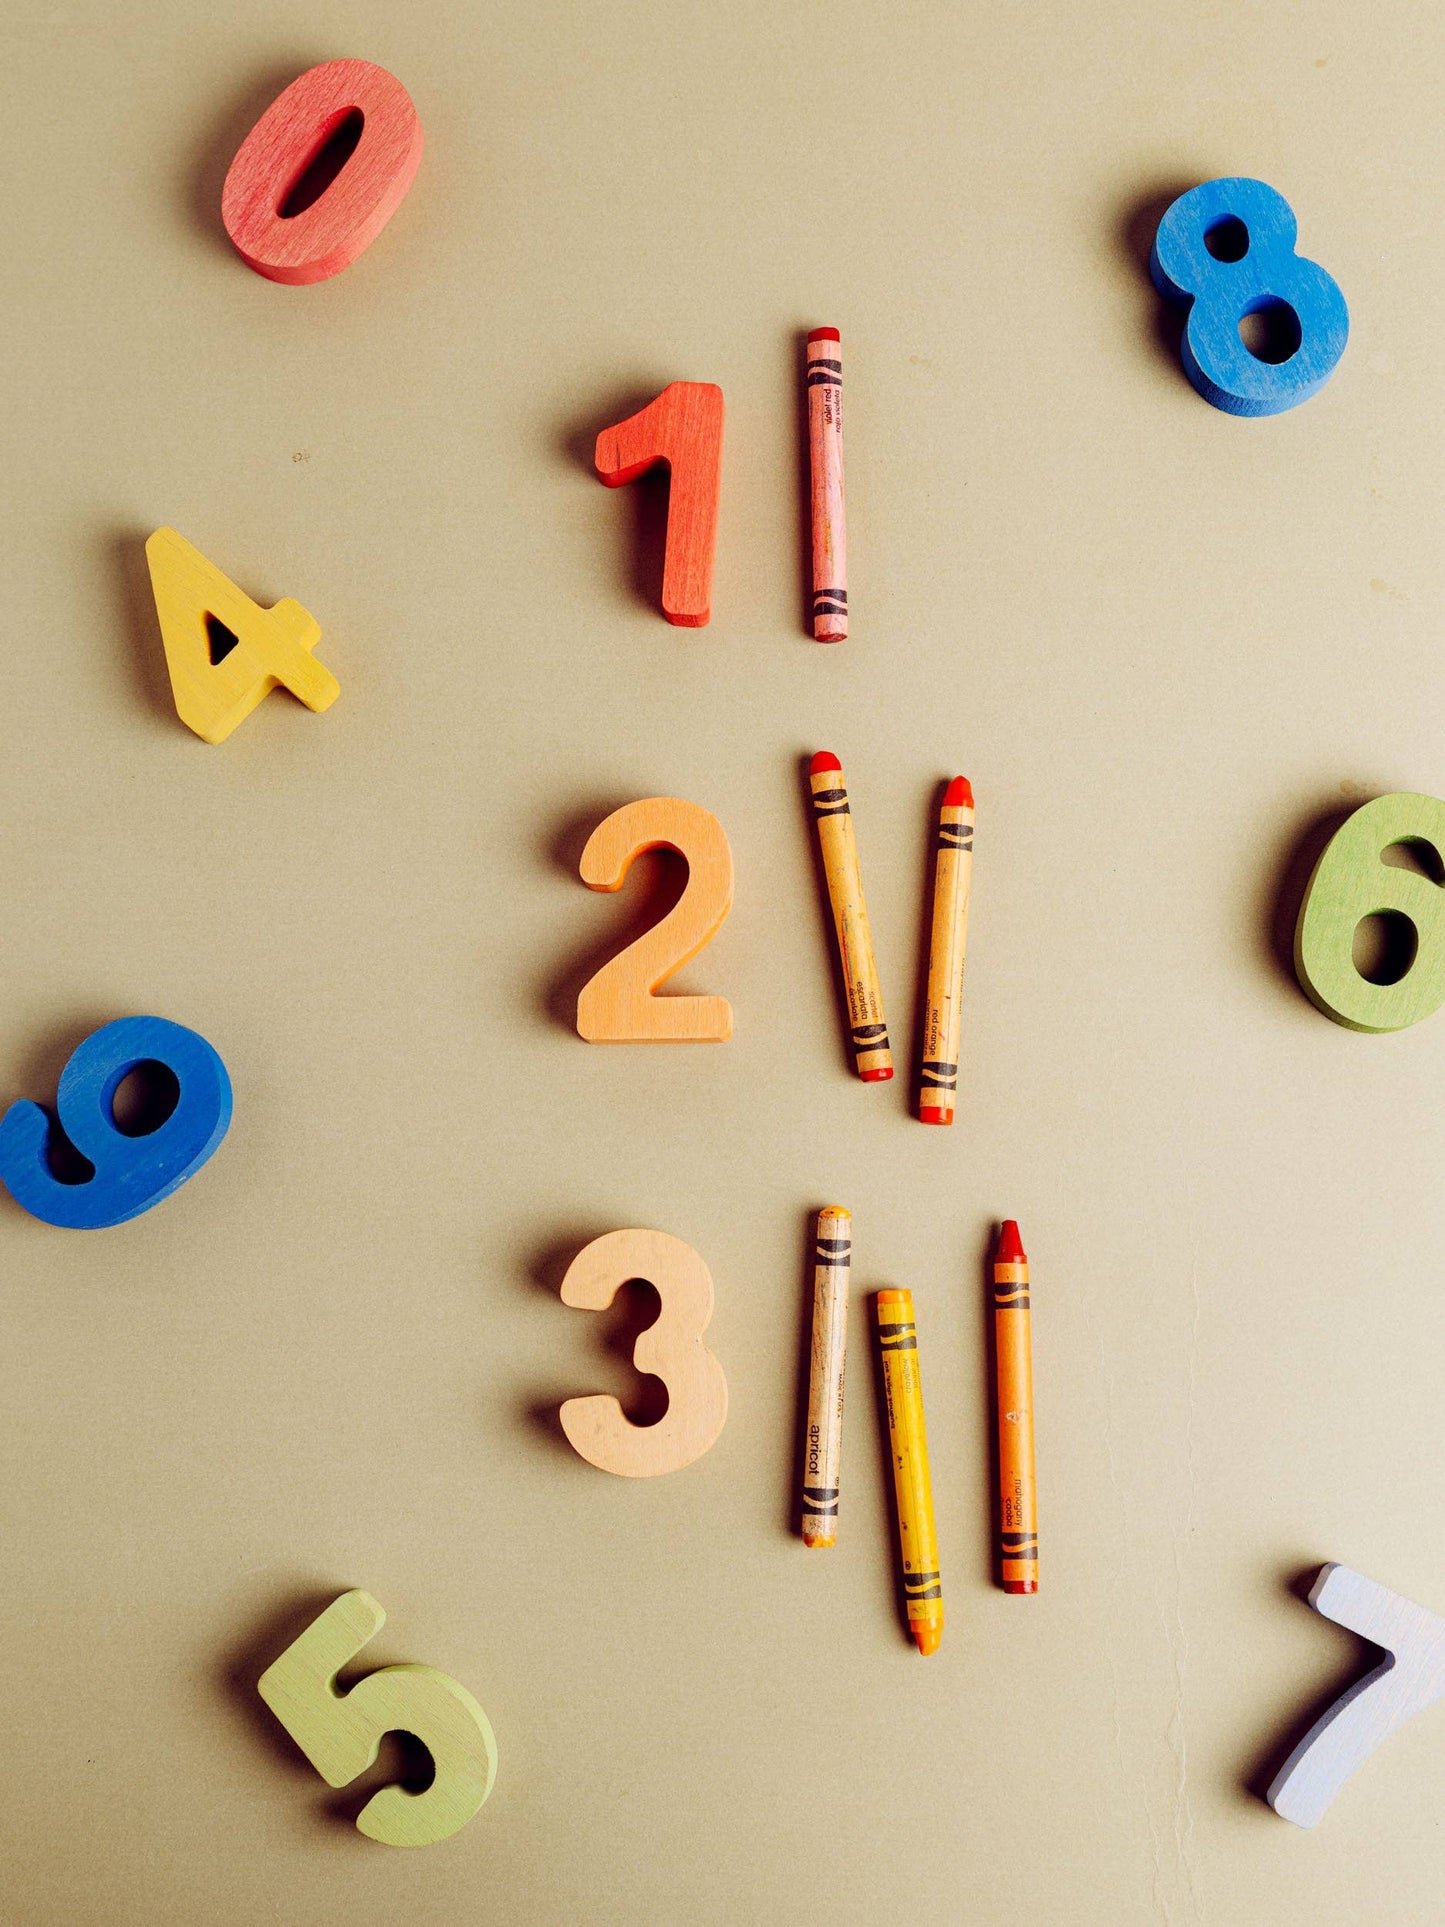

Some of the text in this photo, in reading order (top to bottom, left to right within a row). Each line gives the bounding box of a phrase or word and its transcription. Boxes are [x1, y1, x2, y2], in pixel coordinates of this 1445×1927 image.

[221, 58, 424, 285] 0
[1150, 176, 1350, 417] 8
[595, 381, 725, 627] 1
[824, 389, 832, 424] violet red
[145, 526, 340, 744] 4
[577, 797, 734, 1044] 2
[856, 981, 869, 1020] escarlata
[868, 991, 879, 1019] scarlet
[1293, 791, 1445, 1034] 6
[0, 1015, 233, 1229] 9
[929, 1009, 940, 1056] red orange
[559, 1228, 728, 1478] 3
[808, 1424, 822, 1476] apricot
[1005, 1498, 1013, 1527] caoba
[1014, 1479, 1023, 1527] mahogany
[258, 1588, 498, 1847] 5
[1267, 1562, 1445, 1829] 7
